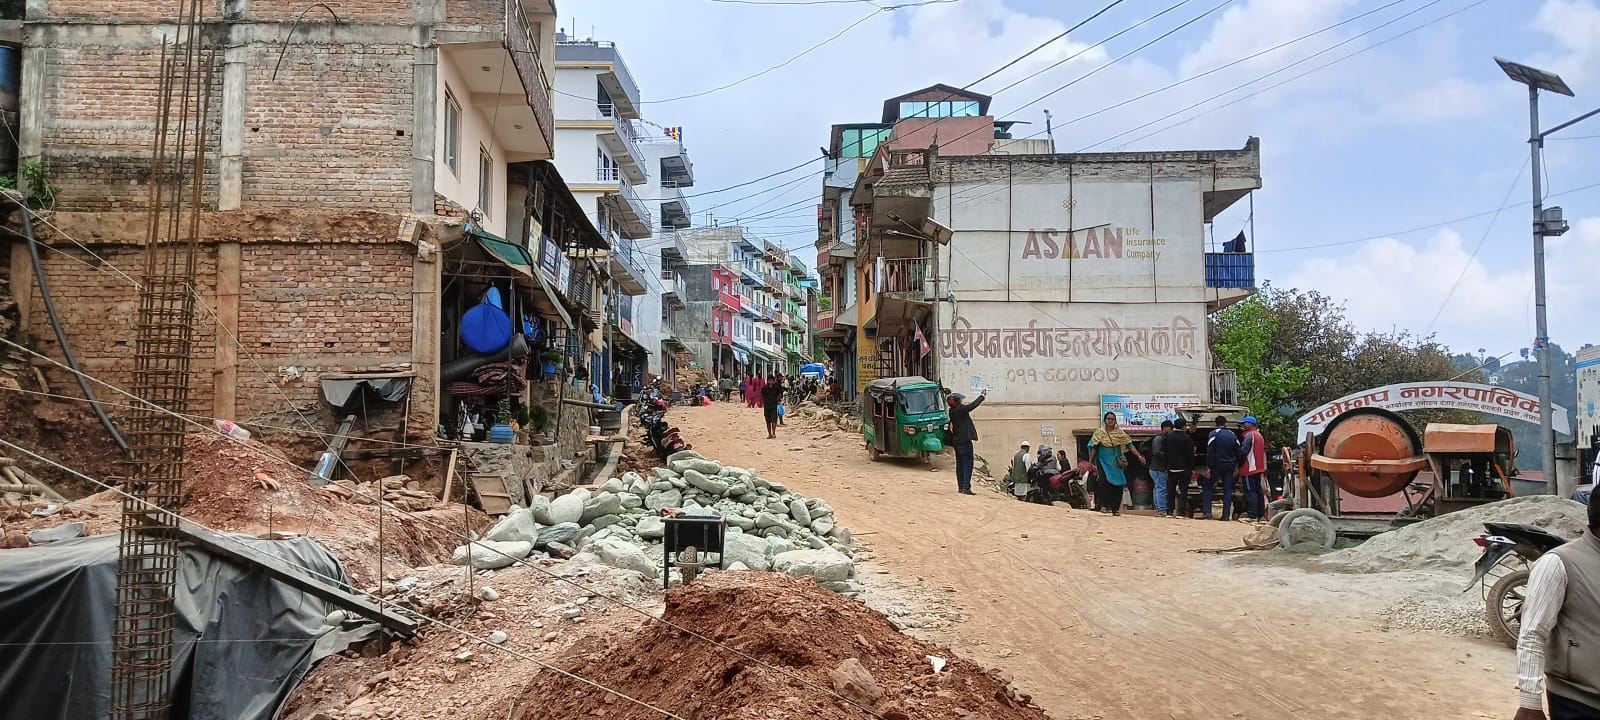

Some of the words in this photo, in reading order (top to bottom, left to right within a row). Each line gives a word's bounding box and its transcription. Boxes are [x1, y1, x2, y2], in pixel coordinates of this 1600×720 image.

[1126, 228, 1141, 236] Life
[1126, 238, 1166, 246] Insurance
[1126, 251, 1161, 261] Company
[939, 316, 1001, 358] एशियन
[1002, 319, 1053, 358] लाईफ
[1303, 389, 1390, 425] रामेछाप
[1400, 386, 1557, 414] नगरपालिक
